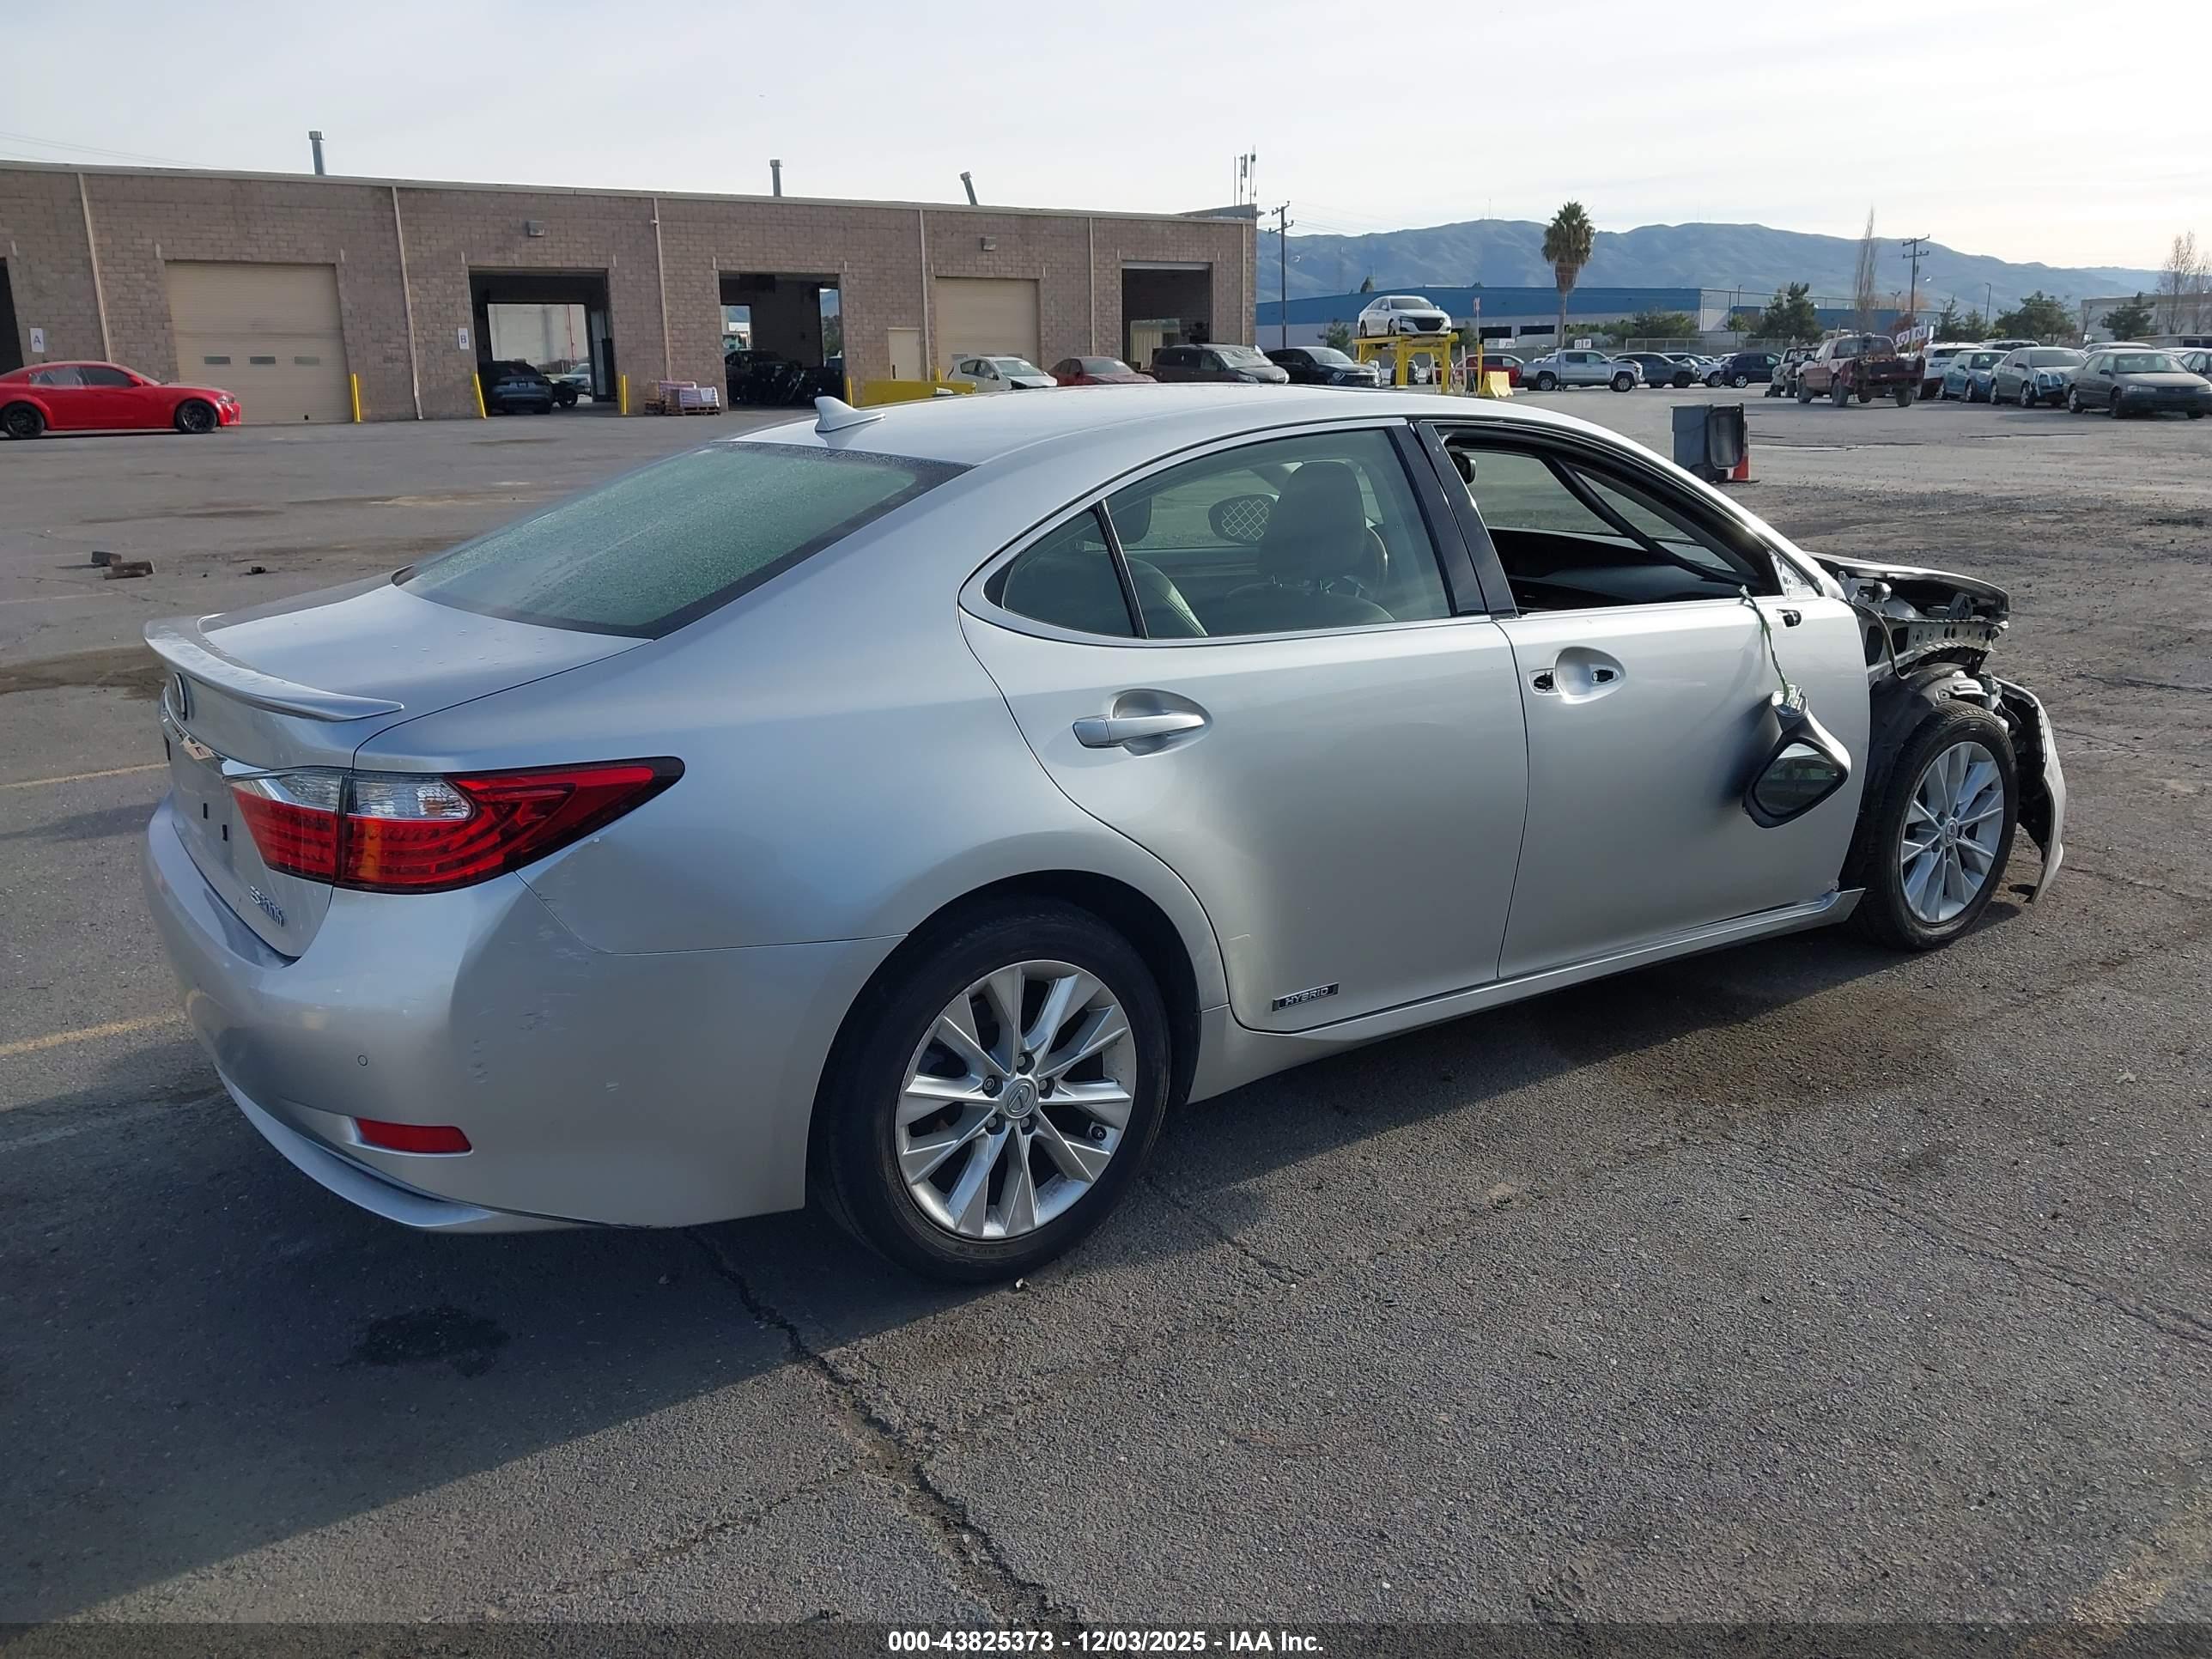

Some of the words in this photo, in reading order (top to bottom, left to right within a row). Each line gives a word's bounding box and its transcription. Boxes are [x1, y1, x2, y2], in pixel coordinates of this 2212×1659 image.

[33, 335, 41, 344] A
[460, 335, 467, 343] B
[1285, 987, 1329, 1006] HYBRID
